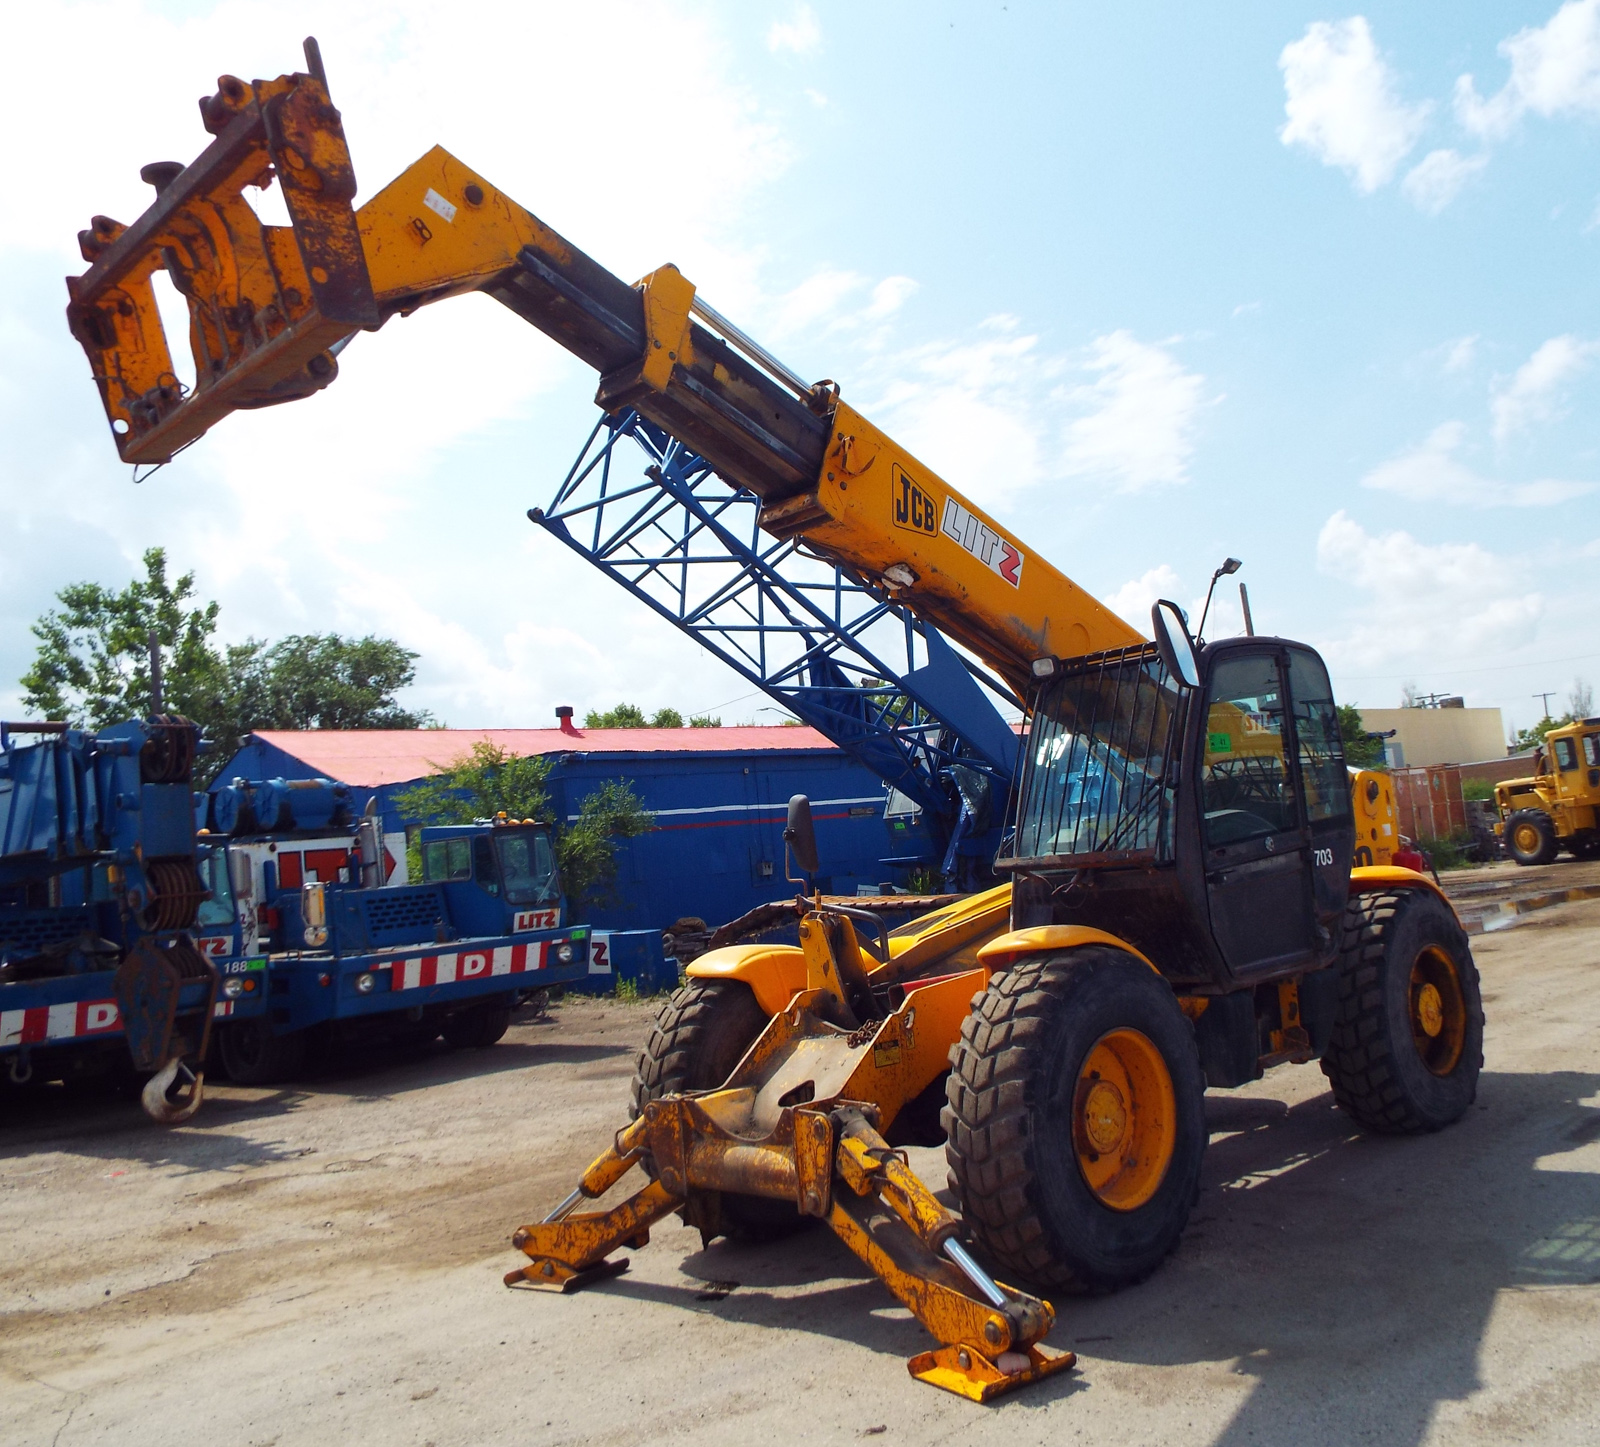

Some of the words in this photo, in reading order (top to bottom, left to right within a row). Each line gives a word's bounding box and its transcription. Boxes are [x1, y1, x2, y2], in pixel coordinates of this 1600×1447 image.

[896, 473, 935, 532] JCB
[942, 498, 1021, 586] LITZ
[1314, 848, 1333, 867] 703
[518, 910, 556, 930] LITZ
[224, 960, 248, 973] 188
[463, 954, 486, 977] D
[87, 1003, 119, 1030] D
